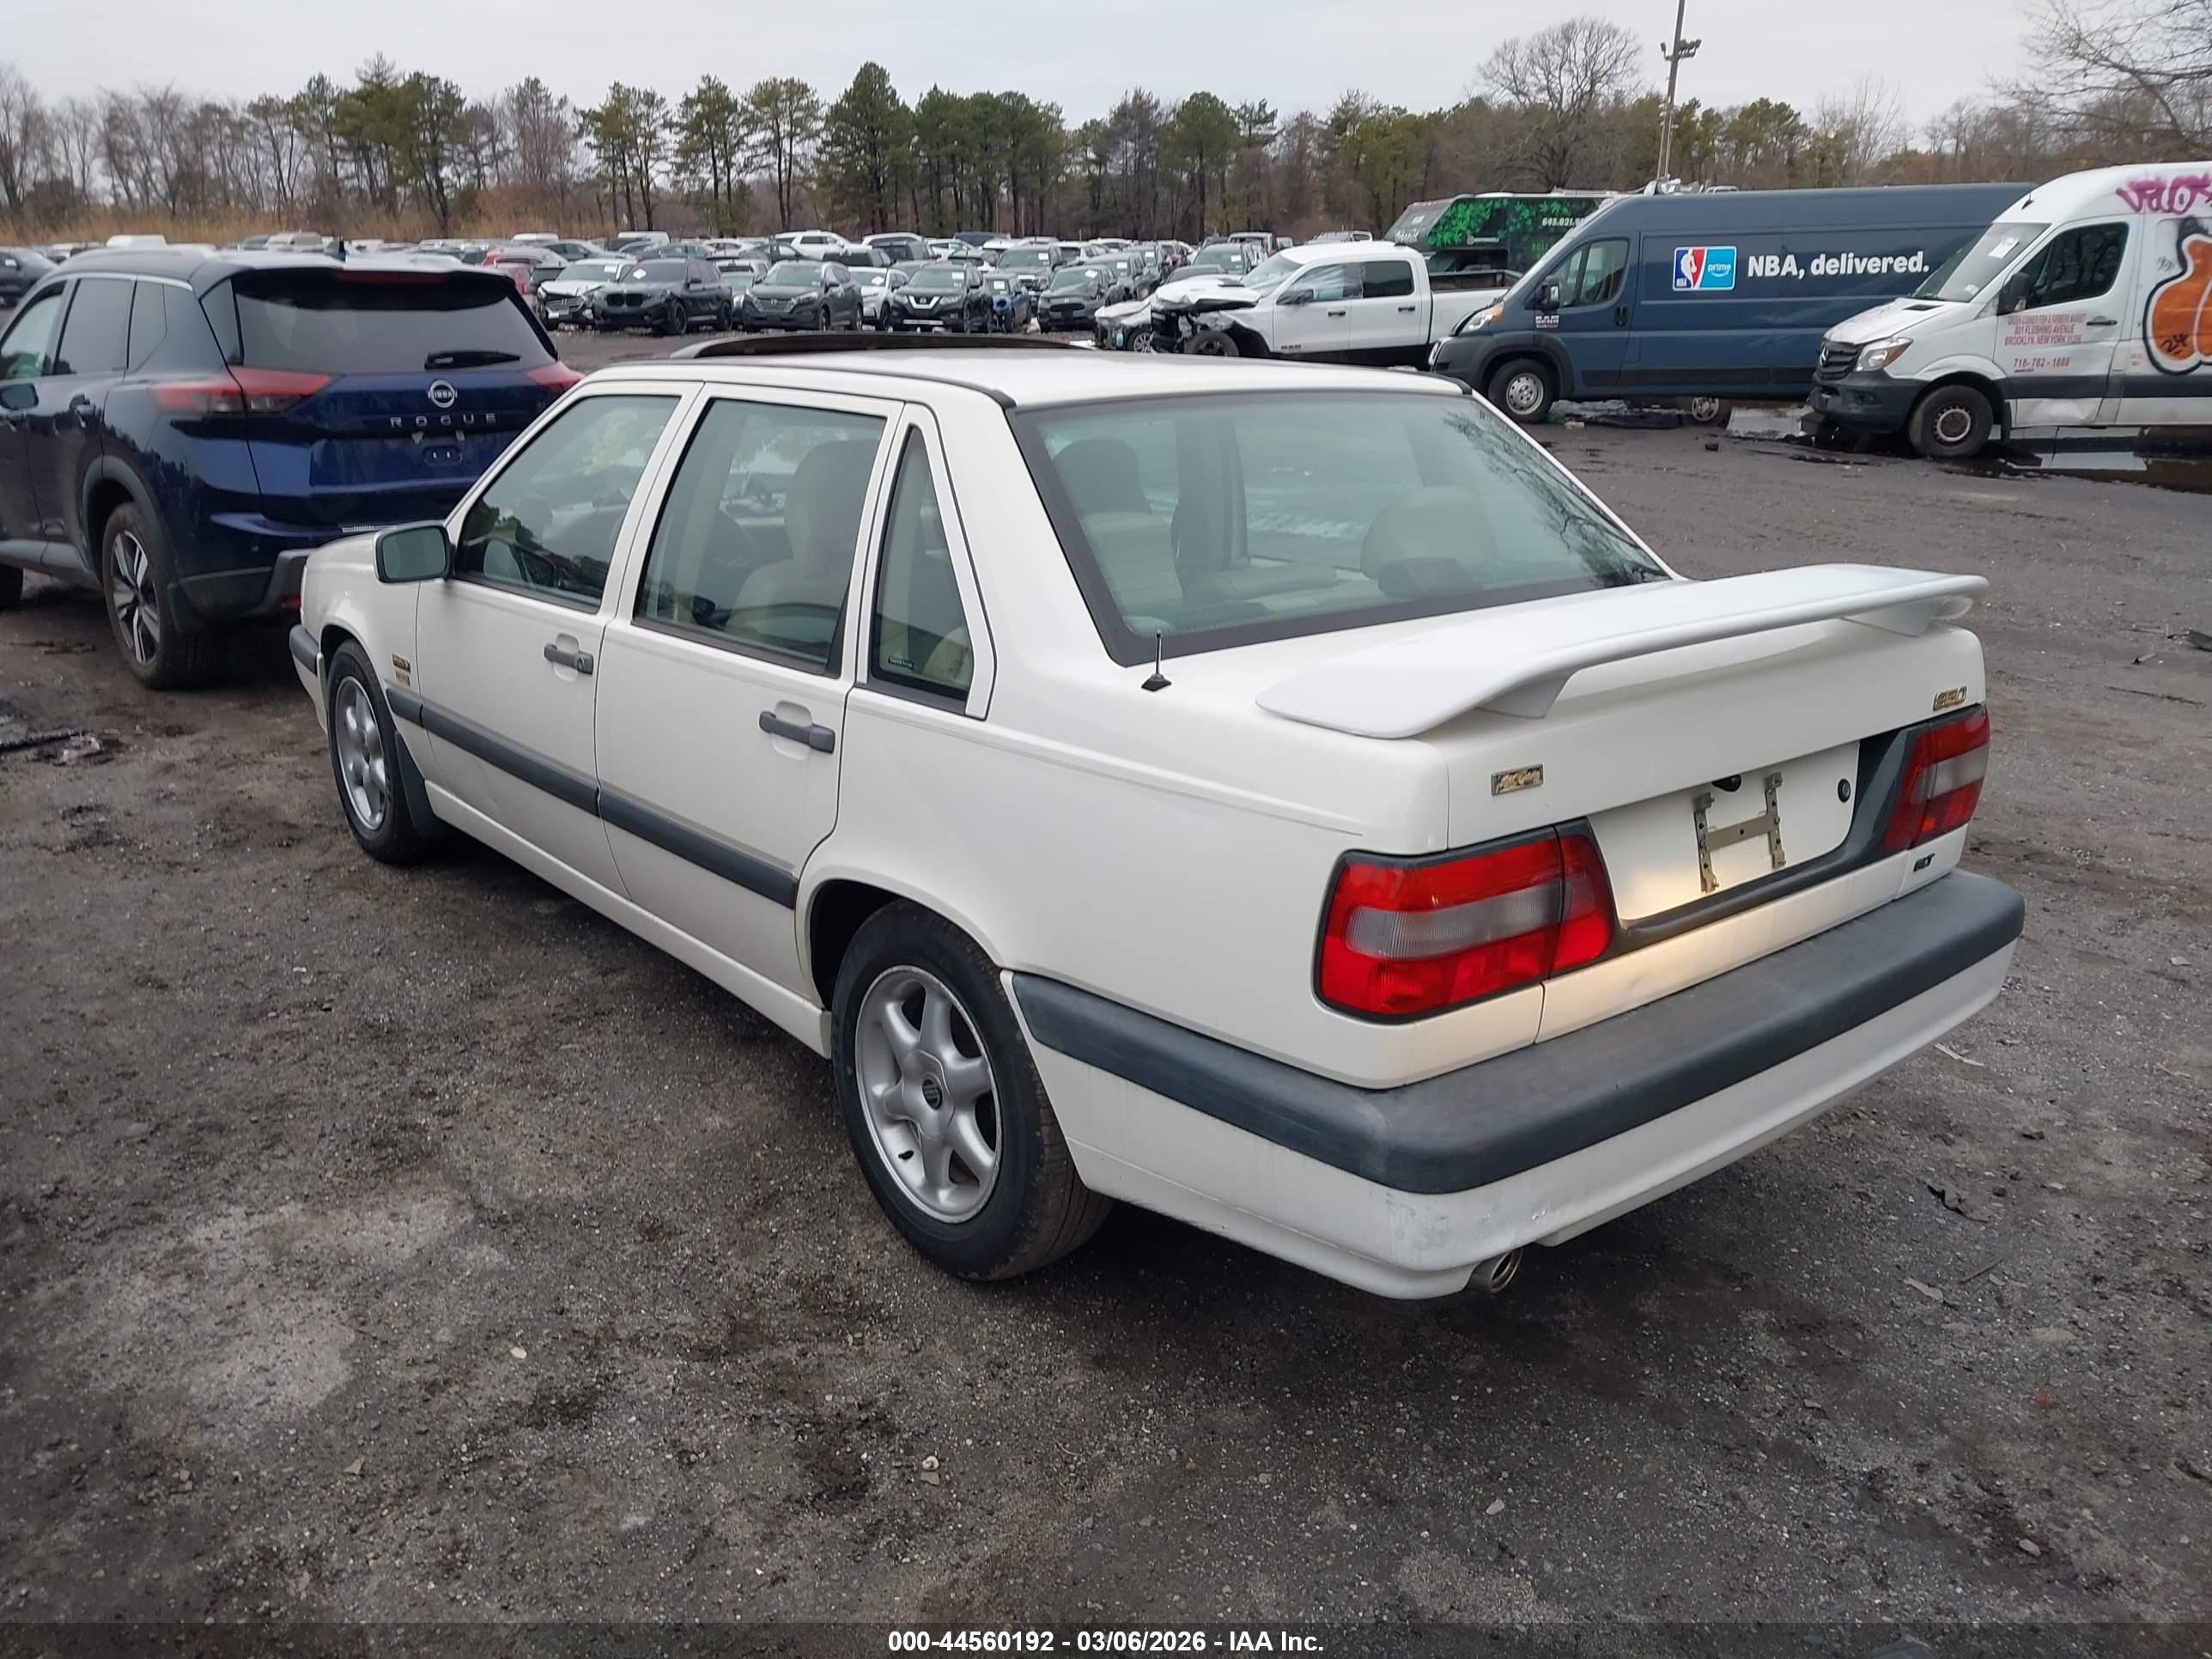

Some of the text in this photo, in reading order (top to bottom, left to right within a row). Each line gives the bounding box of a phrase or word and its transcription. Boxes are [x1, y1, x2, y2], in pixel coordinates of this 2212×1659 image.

[1747, 251, 1930, 279] NBA, delivered.
[1676, 278, 1687, 288] NBA
[2025, 325, 2052, 335] FLUSHING
[2052, 324, 2075, 334] AVENUE
[2037, 336, 2049, 344] NEW
[2050, 335, 2066, 343] YORK
[428, 389, 458, 399] NISSAN
[390, 413, 496, 428] ROGUE
